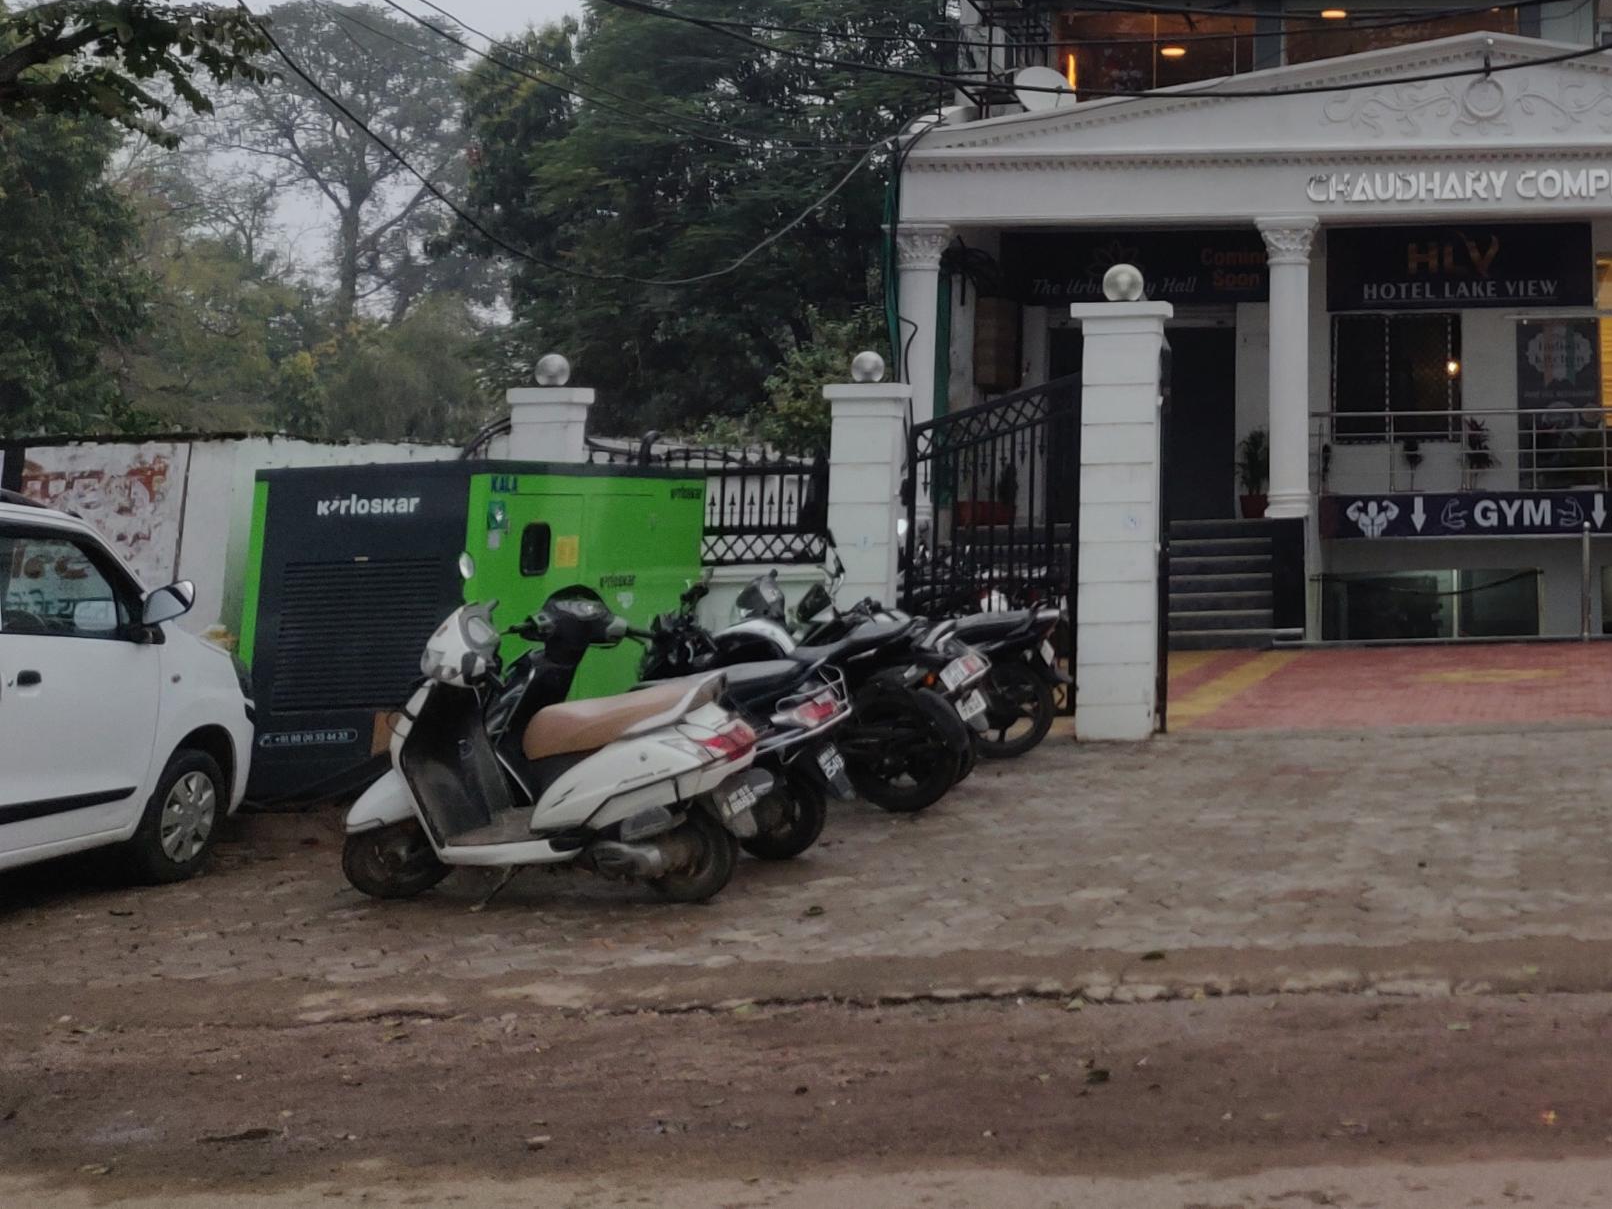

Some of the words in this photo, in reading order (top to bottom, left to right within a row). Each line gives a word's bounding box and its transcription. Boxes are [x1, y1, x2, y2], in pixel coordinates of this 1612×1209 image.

[1307, 170, 1508, 202] CHAUDHARY
[1201, 248, 1267, 266] Comin
[1407, 230, 1500, 277] HLV
[1032, 279, 1061, 295] The
[1066, 278, 1104, 295] Urba
[1161, 276, 1198, 293] Hall
[1212, 269, 1261, 288] Soon
[1363, 281, 1436, 300] HOTEL
[1445, 280, 1497, 298] LAKE
[1505, 279, 1558, 296] VIEW
[1474, 499, 1552, 527] GYM
